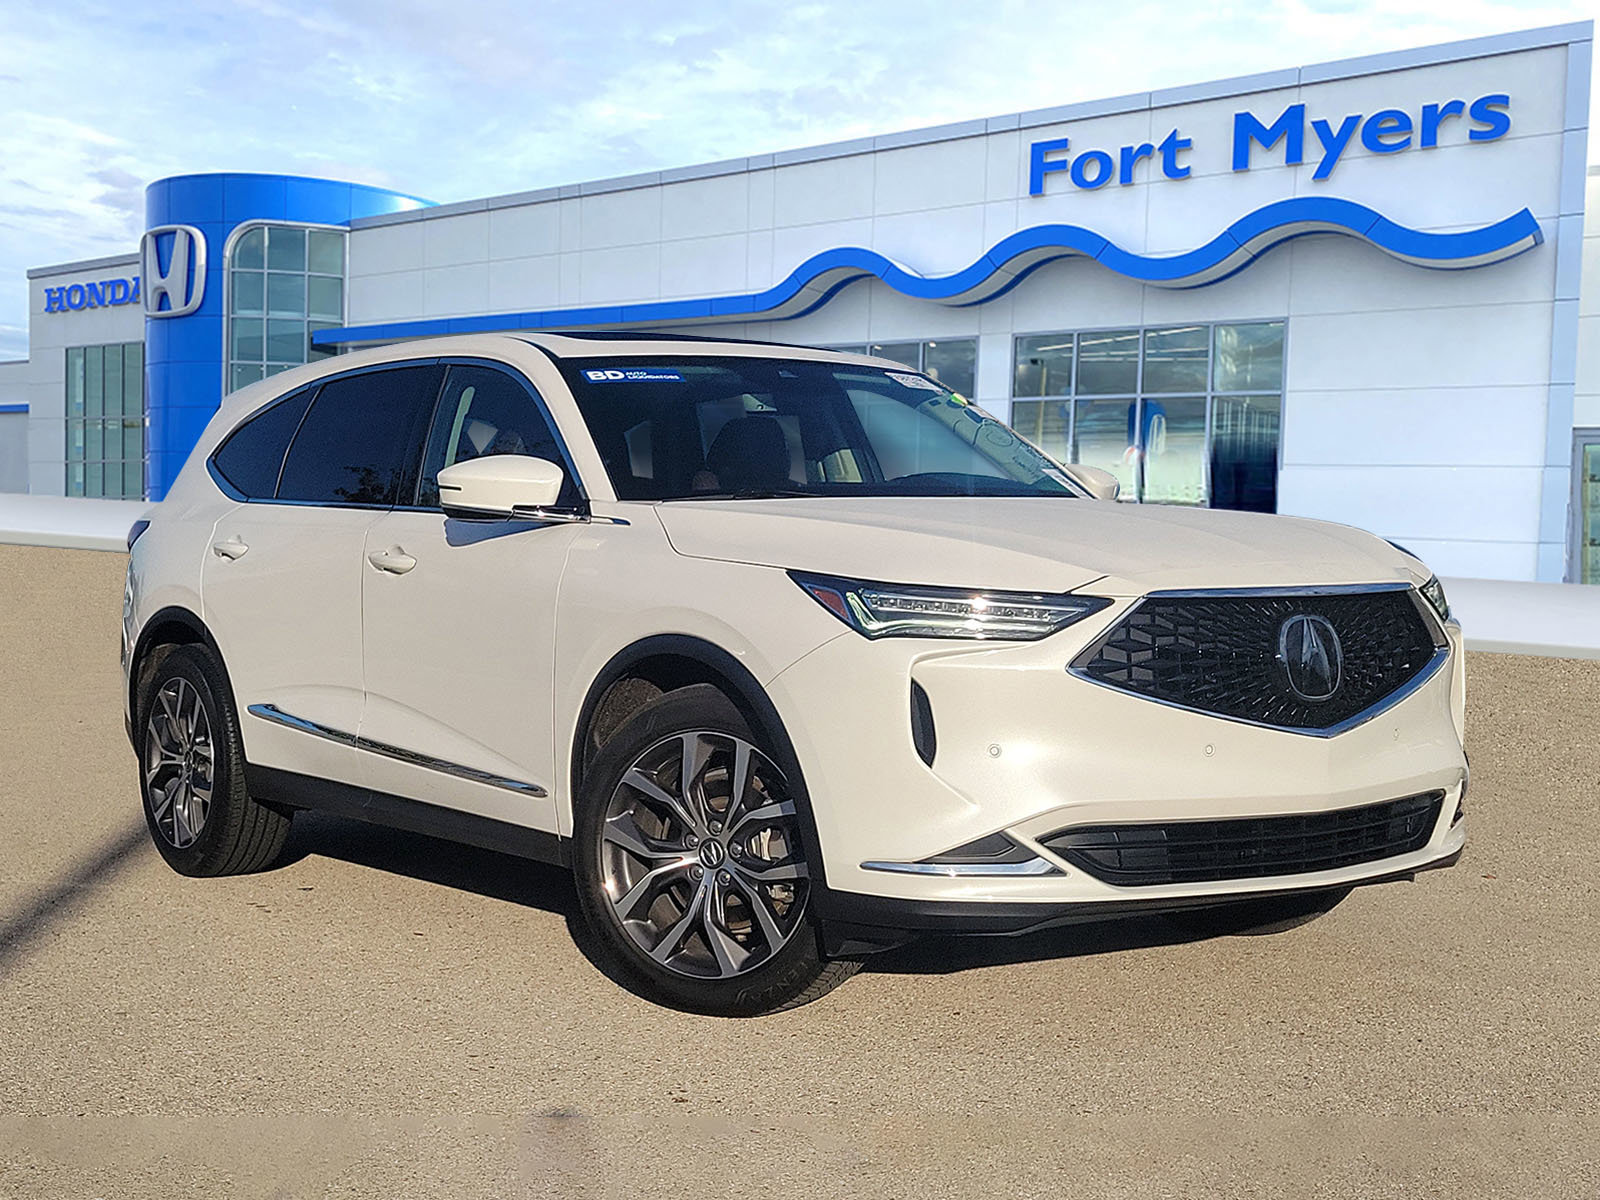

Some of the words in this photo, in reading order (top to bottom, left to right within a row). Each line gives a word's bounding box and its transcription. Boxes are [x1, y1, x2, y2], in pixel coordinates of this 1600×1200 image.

[1029, 128, 1193, 197] Fort
[1232, 93, 1512, 181] Myers
[586, 370, 625, 381] BD
